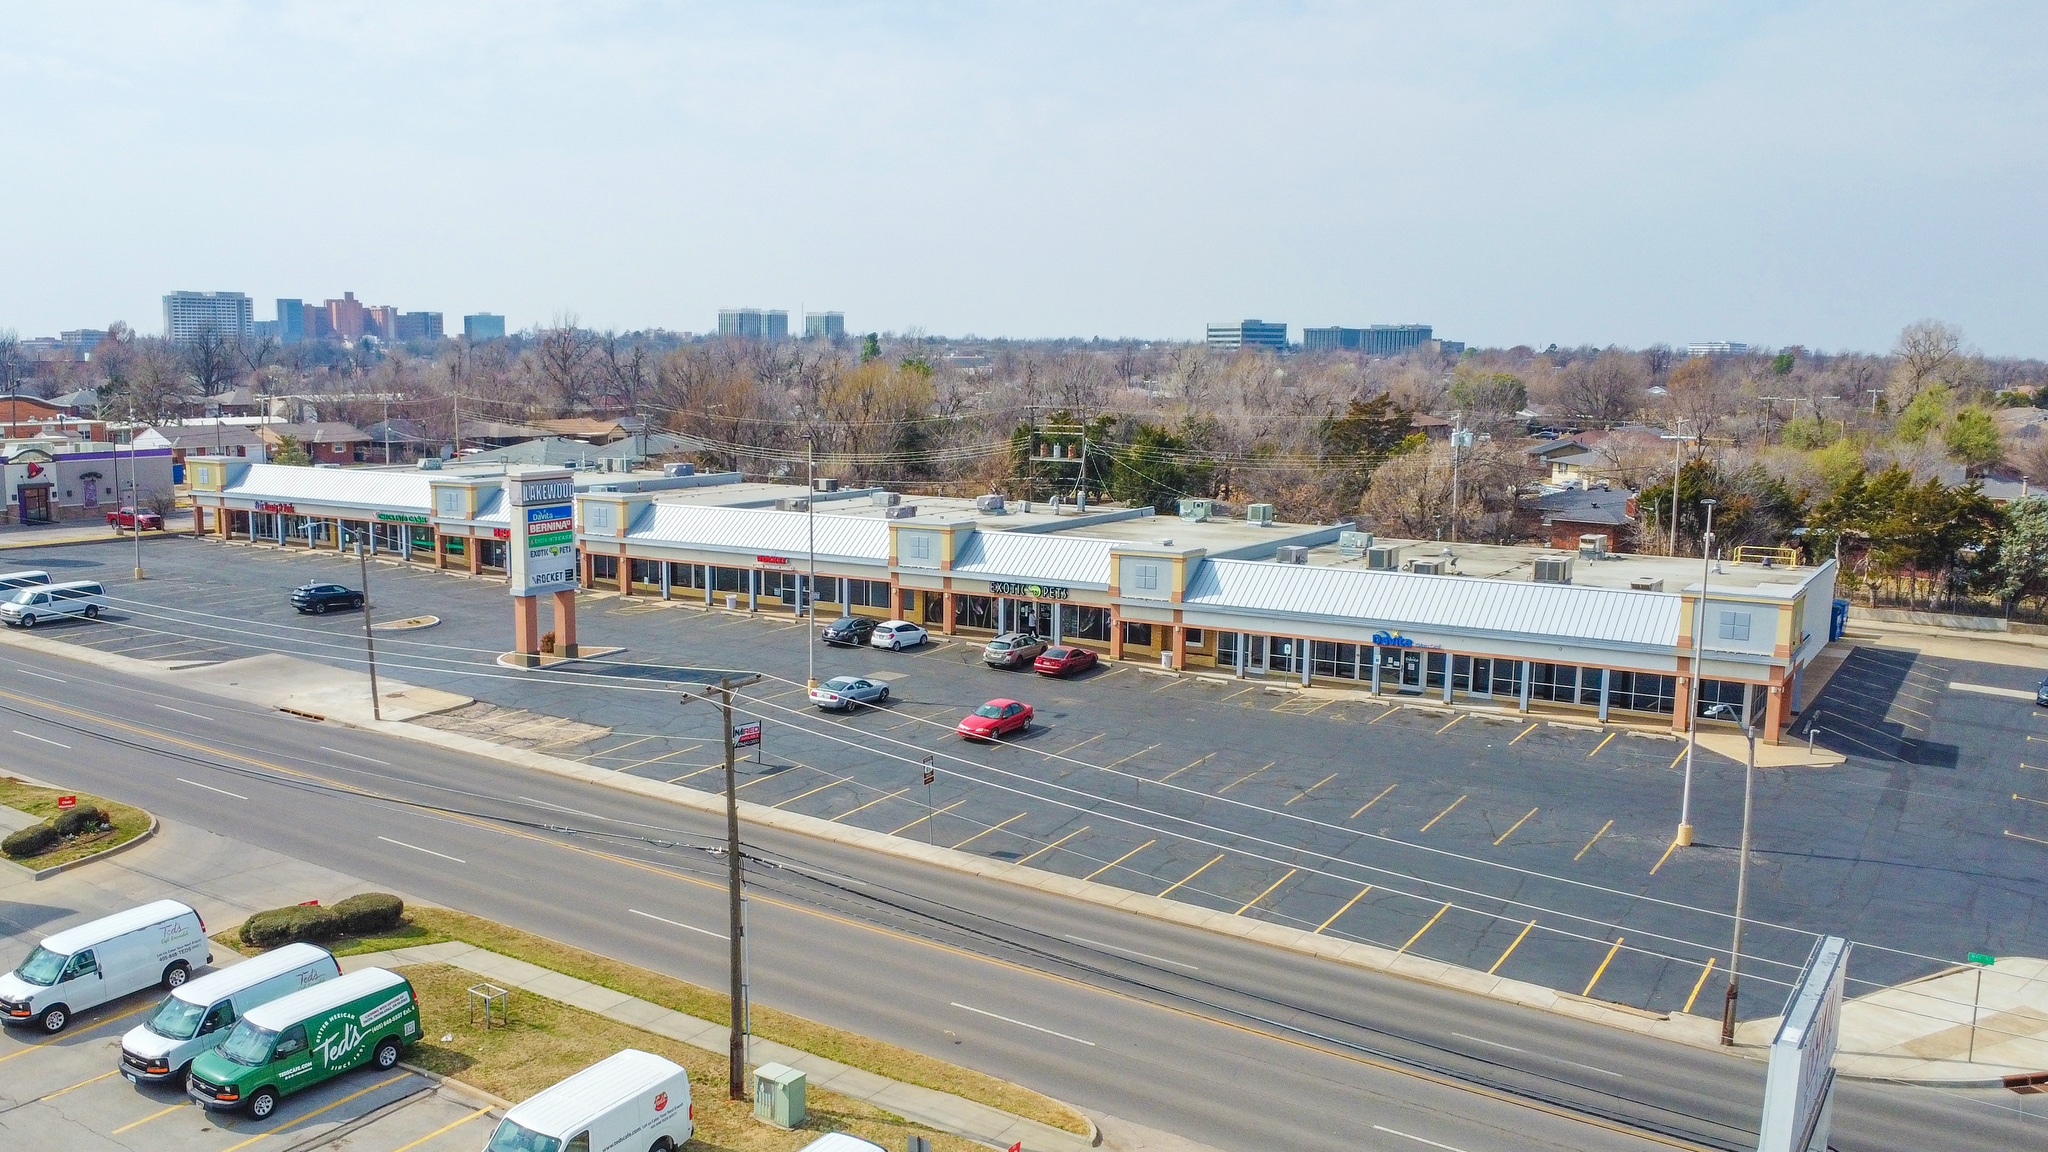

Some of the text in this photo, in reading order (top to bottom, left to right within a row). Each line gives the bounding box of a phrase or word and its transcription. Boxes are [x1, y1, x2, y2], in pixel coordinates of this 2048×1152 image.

[525, 482, 574, 501] LAKEWOOD
[533, 510, 553, 521] DaVita
[530, 521, 567, 533] BERNINA
[530, 545, 572, 558] EXOTIC PETS
[536, 571, 564, 584] ROCKET
[989, 581, 1069, 600] EXOTIC PETS
[1372, 630, 1413, 648] DaVita
[159, 922, 190, 938] Ted's
[296, 968, 326, 986] Ted's
[316, 1012, 355, 1043] BETTER MEXICAN
[312, 1023, 372, 1068] Ted's
[331, 1061, 351, 1071] SINCE
